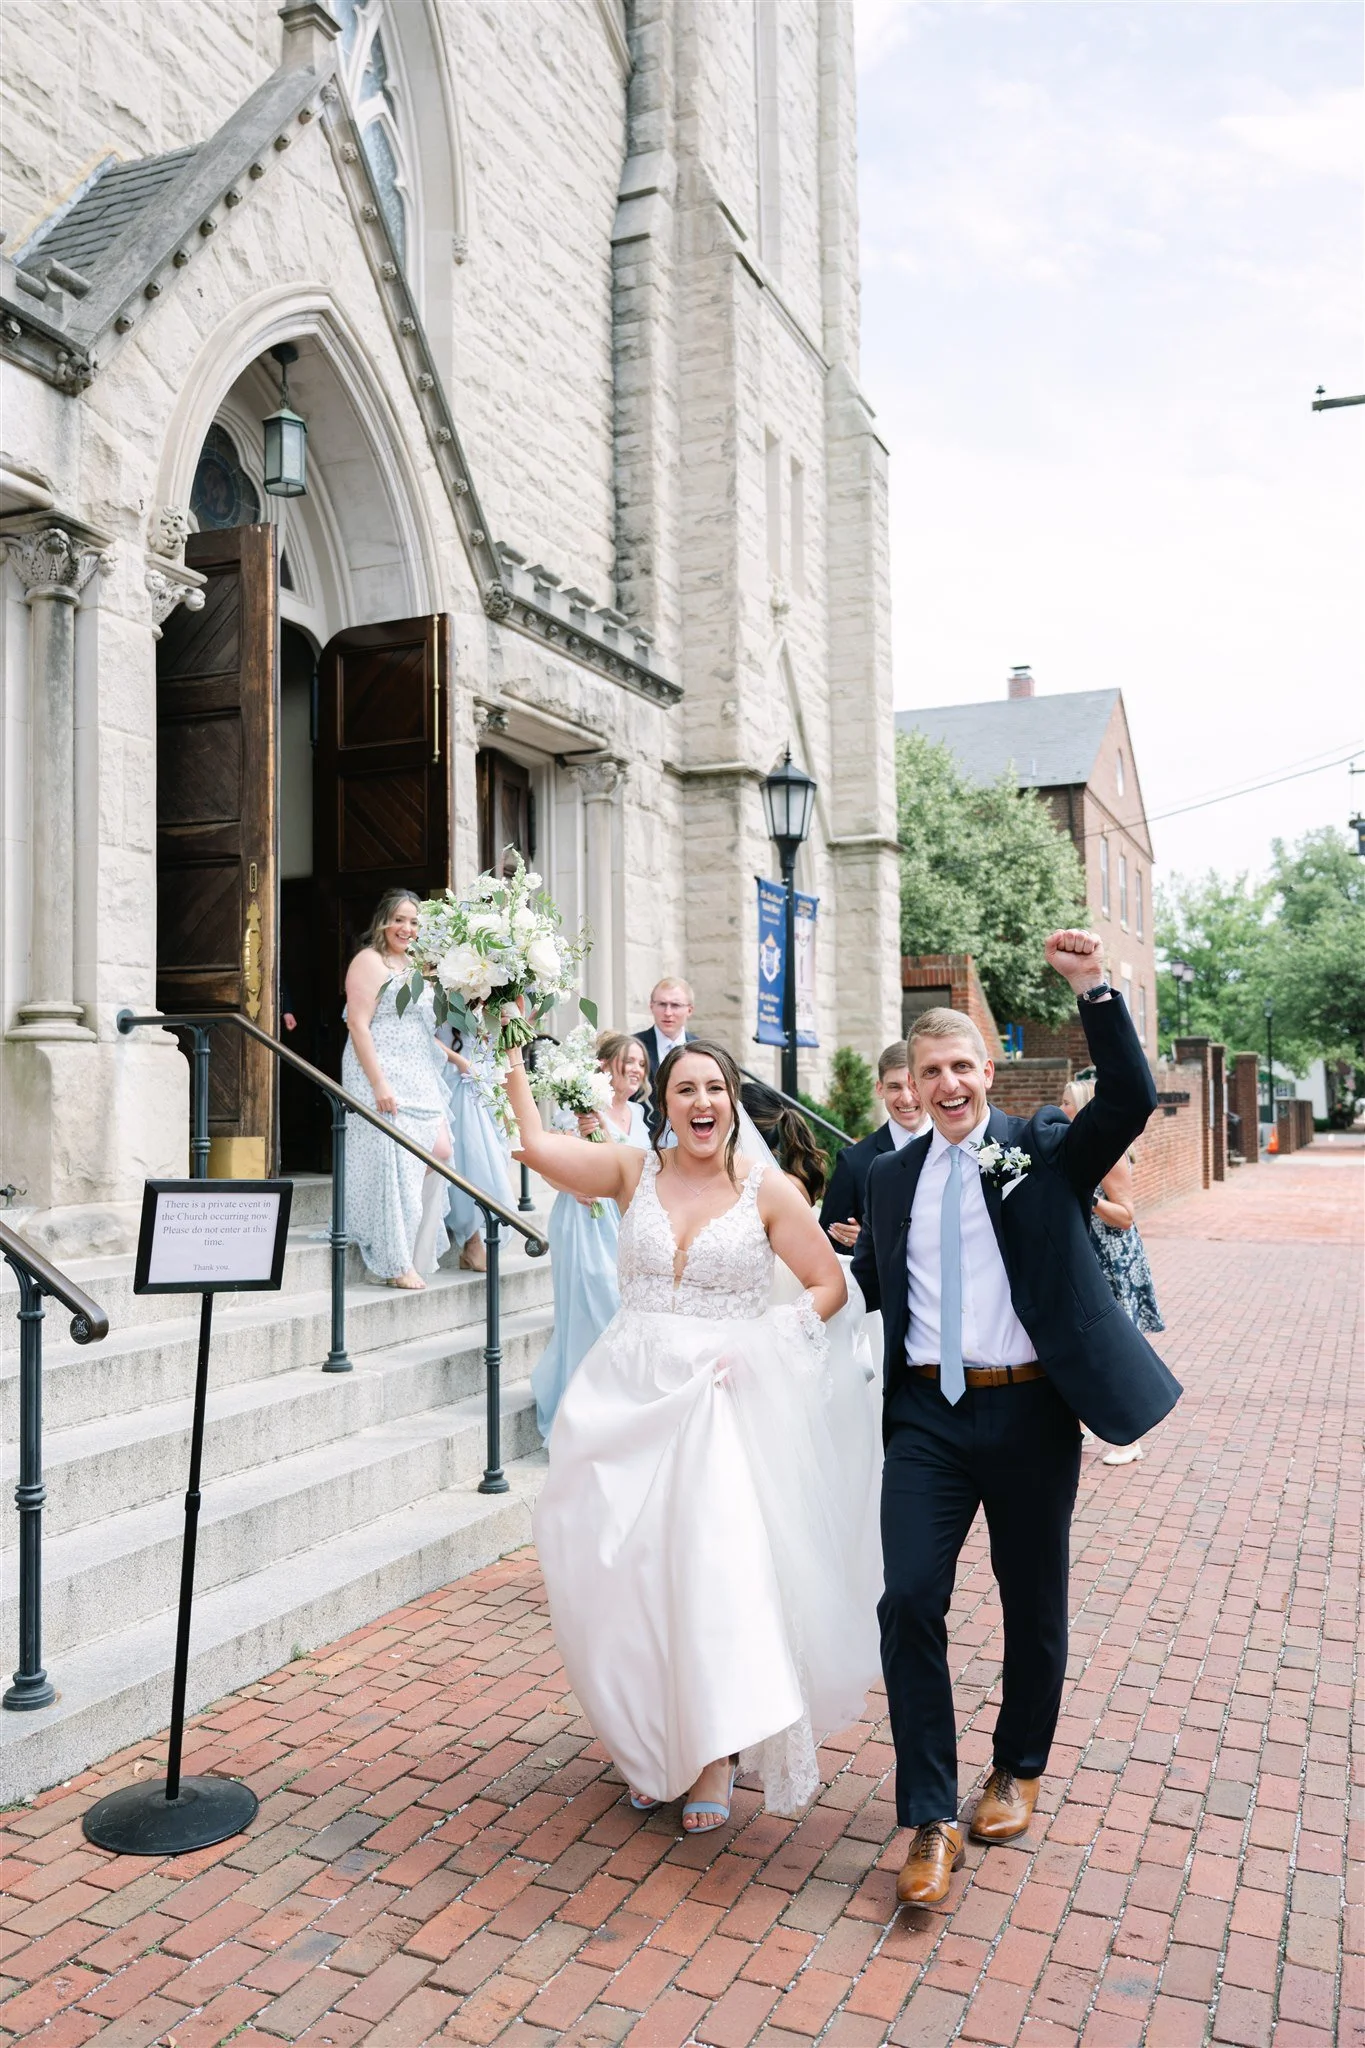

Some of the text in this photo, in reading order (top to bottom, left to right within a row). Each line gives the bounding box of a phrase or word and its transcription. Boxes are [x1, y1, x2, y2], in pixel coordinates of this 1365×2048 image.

[165, 1200, 189, 1208] There
[208, 1200, 237, 1209] private
[239, 1200, 261, 1208] event
[210, 1213, 248, 1222] occurring
[163, 1226, 189, 1234] Please
[252, 1225, 267, 1233] this
